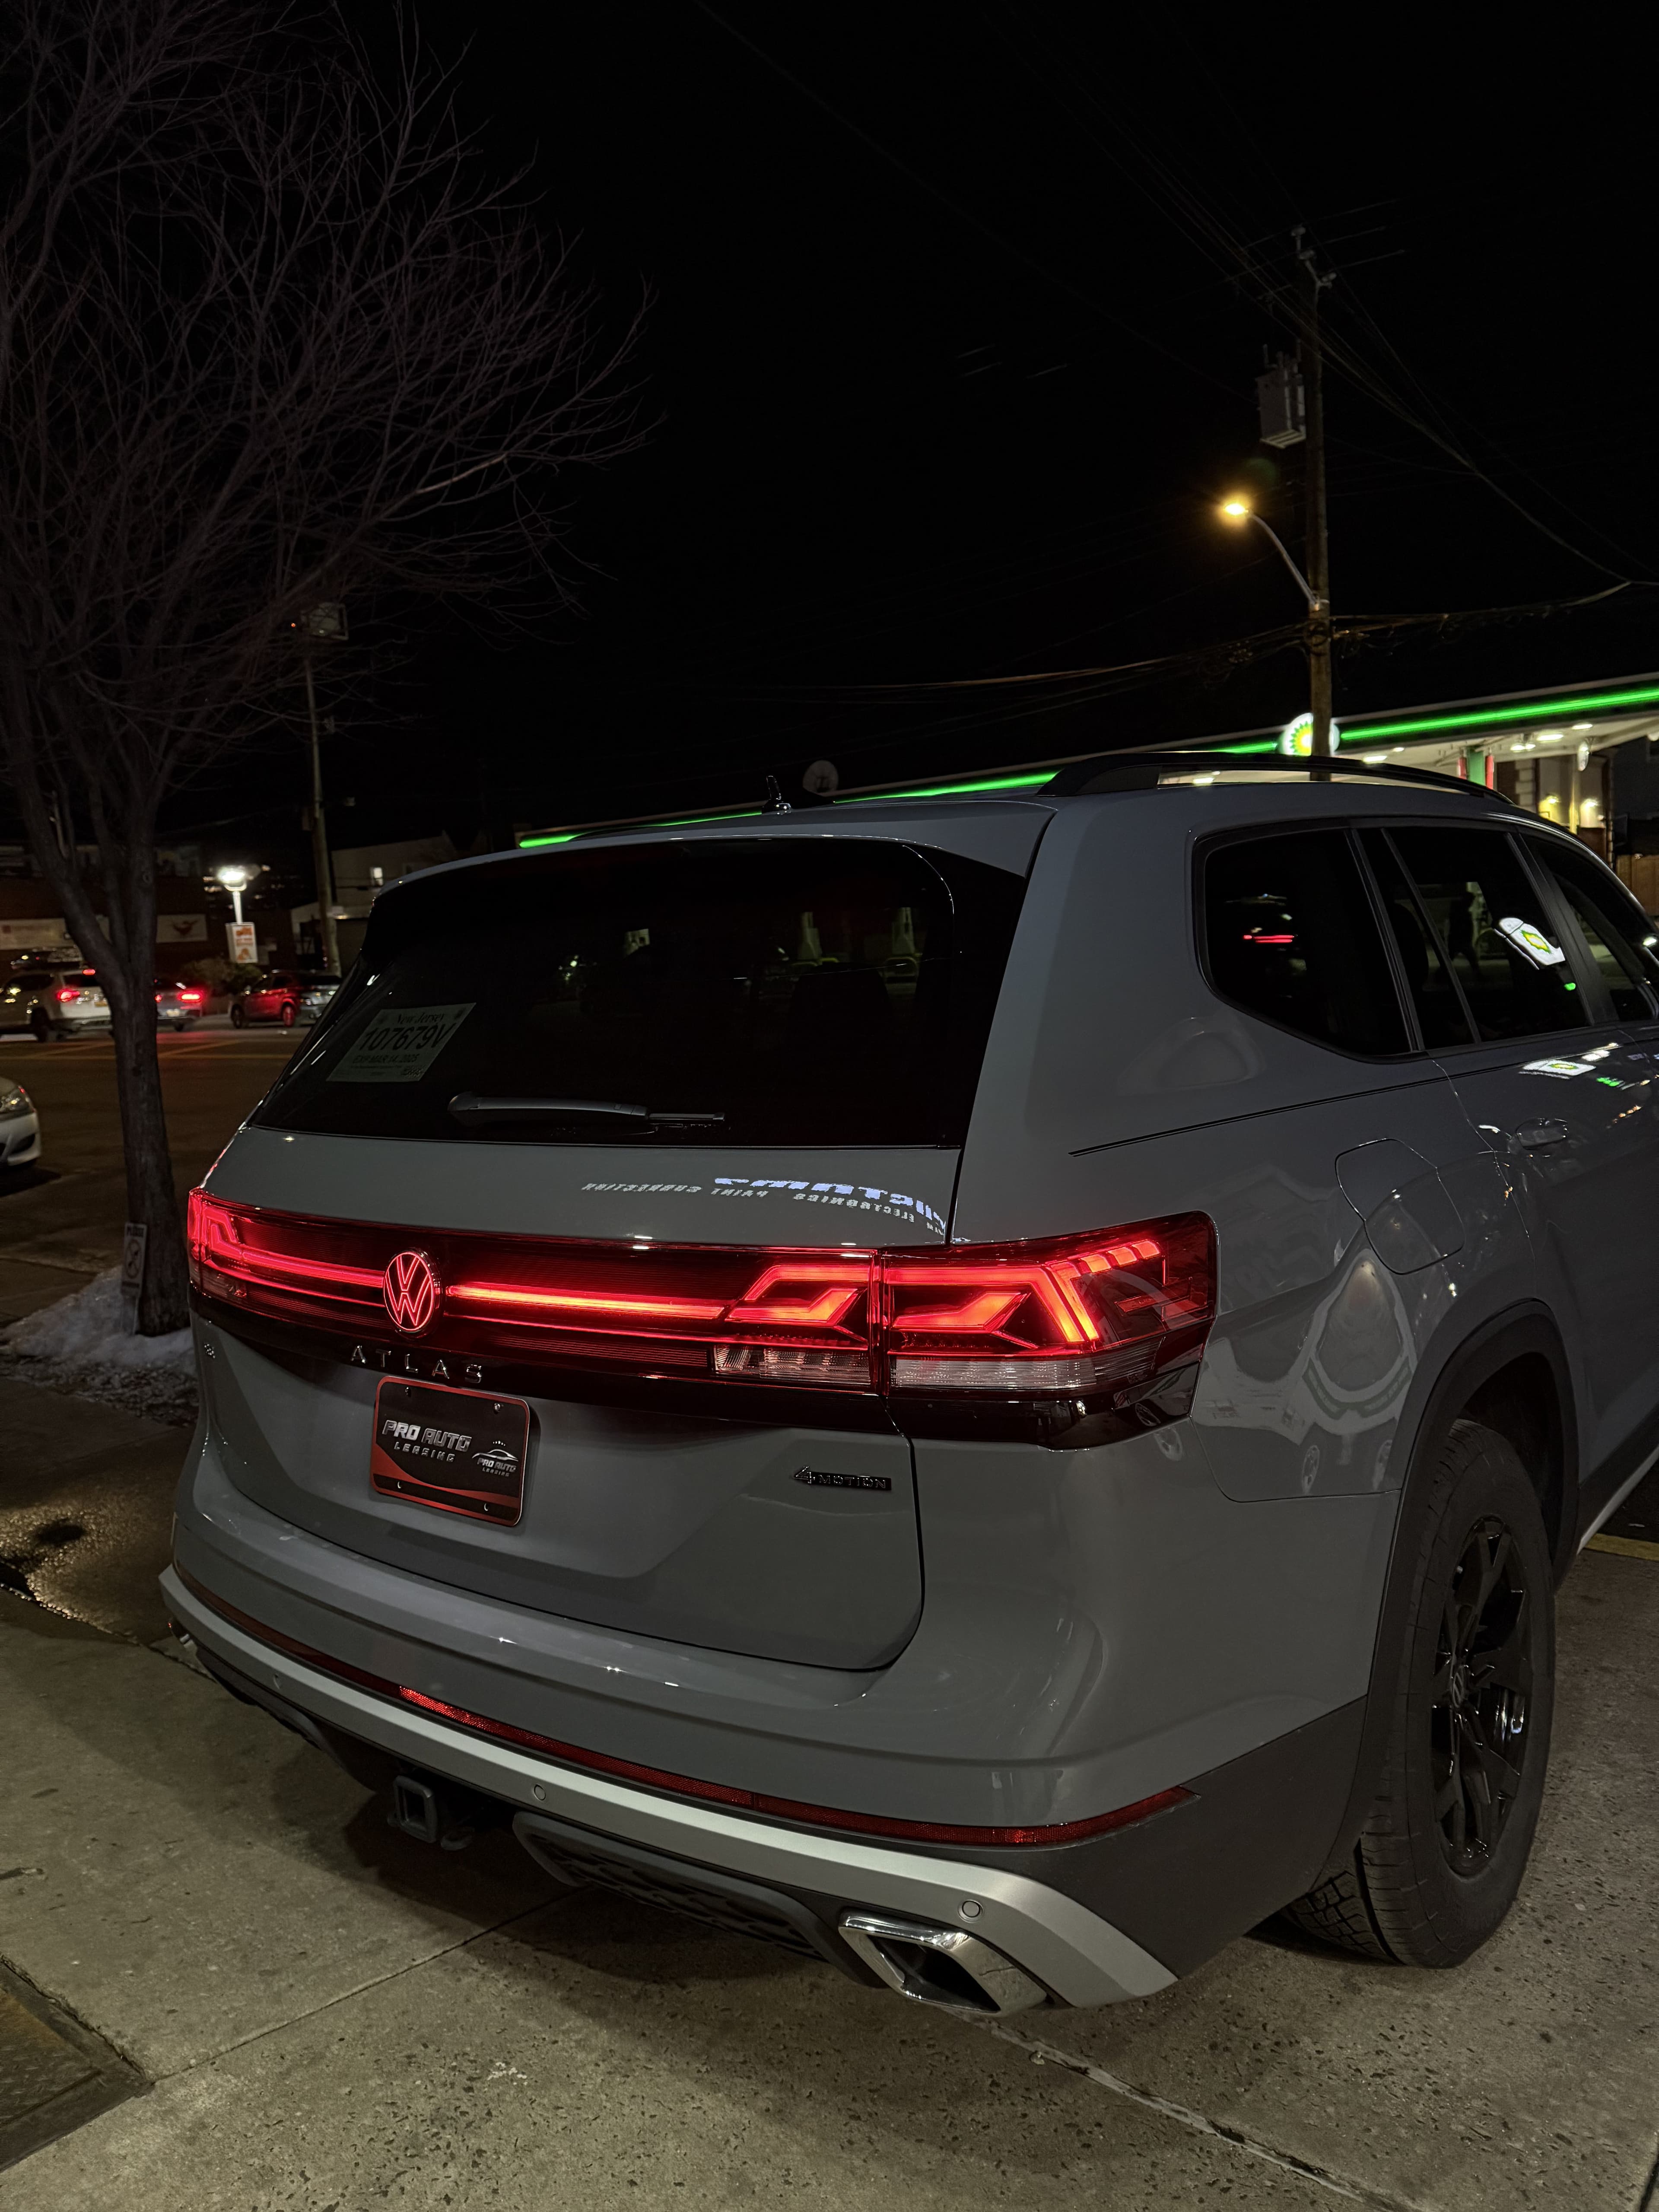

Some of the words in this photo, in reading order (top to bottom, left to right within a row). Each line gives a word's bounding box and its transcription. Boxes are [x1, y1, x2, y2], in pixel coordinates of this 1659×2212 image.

[415, 1012, 445, 1023] Jersey
[359, 1023, 457, 1051] 107679V
[350, 1344, 483, 1384] ATLAS
[382, 1419, 422, 1441] PRO
[421, 1427, 473, 1452] AUTO
[394, 1441, 456, 1462] LEASING
[477, 1457, 495, 1468] PRO
[494, 1461, 518, 1472] AUTO
[793, 1465, 886, 1489] 4MOTION
